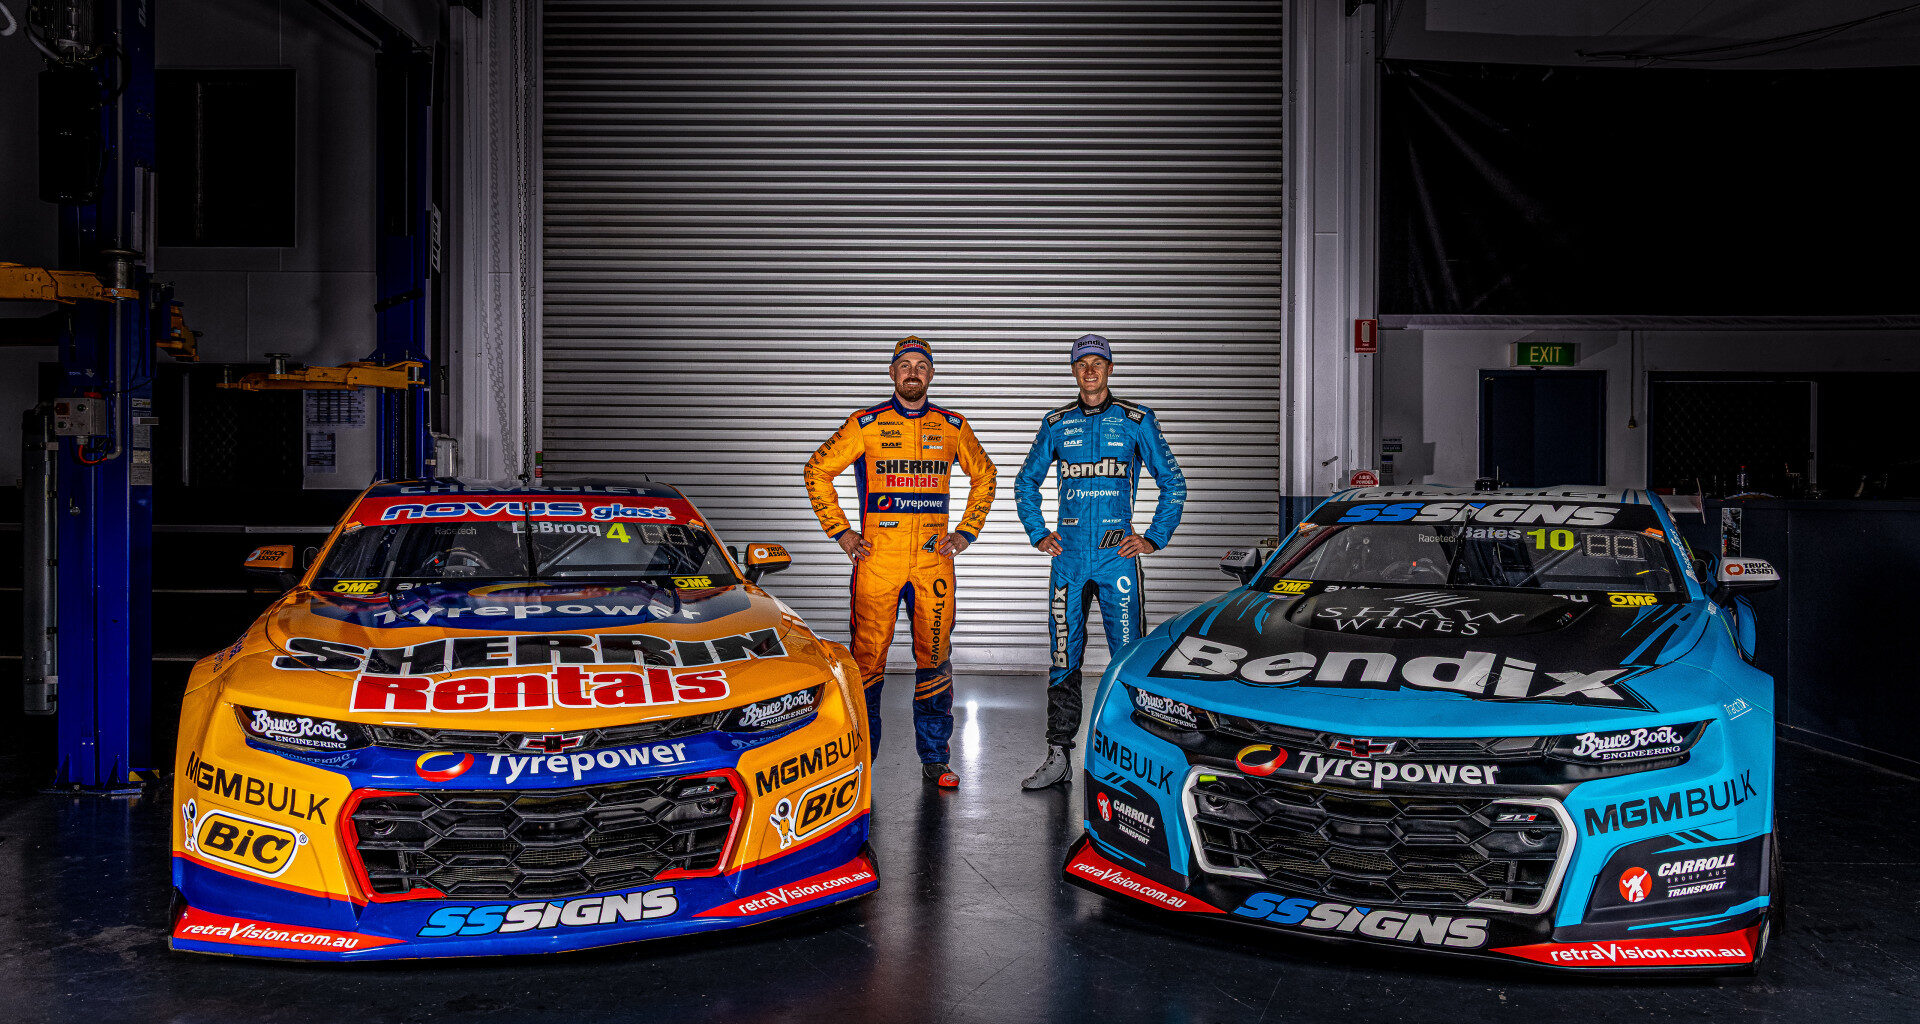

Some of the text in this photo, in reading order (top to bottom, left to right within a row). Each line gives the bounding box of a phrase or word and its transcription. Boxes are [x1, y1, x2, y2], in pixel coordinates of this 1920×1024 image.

[1077, 340, 1104, 348] Bendix
[1530, 346, 1562, 362] EXIT
[876, 460, 948, 475] SHERRIN
[1061, 458, 1128, 478] Bendix
[400, 485, 653, 494] CHEVROLET
[886, 474, 938, 488] Rentals
[894, 498, 943, 508] Tyrepower
[1076, 488, 1120, 498] Tyrepower
[381, 501, 586, 521] novus
[434, 526, 477, 536] Racetech
[606, 522, 632, 543] 4
[1099, 529, 1125, 550] 10
[1527, 529, 1574, 550] 10
[922, 534, 938, 553] 4
[333, 582, 378, 594] OMP
[674, 578, 712, 588] OMP
[1274, 581, 1310, 592] OMP
[1609, 595, 1658, 606] OMP
[374, 603, 700, 624] Tyrepower
[1316, 606, 1526, 626] SHAW
[931, 600, 945, 667] Tyrepower
[1054, 583, 1068, 668] Bendix
[1334, 618, 1480, 636] WINES
[272, 627, 788, 676] SHERRIN
[1161, 635, 1629, 701] Bendix
[350, 665, 730, 712] Rentals
[738, 690, 814, 727] Bruce Rock
[1135, 688, 1197, 722] Bruce Rock
[250, 709, 348, 741] Bruce Rock
[760, 705, 813, 728] ENGINEERING
[1151, 710, 1197, 729] ENGINEERING
[275, 735, 347, 749] ENGINEERING
[1573, 727, 1683, 757] Bruce Rock
[1602, 744, 1681, 760] ENGINEERING
[487, 740, 686, 784] Tyrepower
[755, 726, 864, 798] MGMBULK
[1298, 751, 1500, 788] Tyrepower
[185, 751, 330, 826] MGMBULK
[1584, 769, 1757, 836] MGMBULK
[1113, 800, 1156, 829] CARROLL
[1118, 824, 1150, 845] TRANSPORT
[1658, 853, 1736, 878] CARROLL
[1072, 862, 1186, 908] retraVision.com.au
[1667, 869, 1727, 884] GROUP AUS
[738, 870, 872, 914] retraVision.com.au
[1668, 881, 1726, 898] TRANSPORT
[182, 922, 360, 950] retraVision.com.au
[1550, 943, 1746, 963] retraVision.com.au
